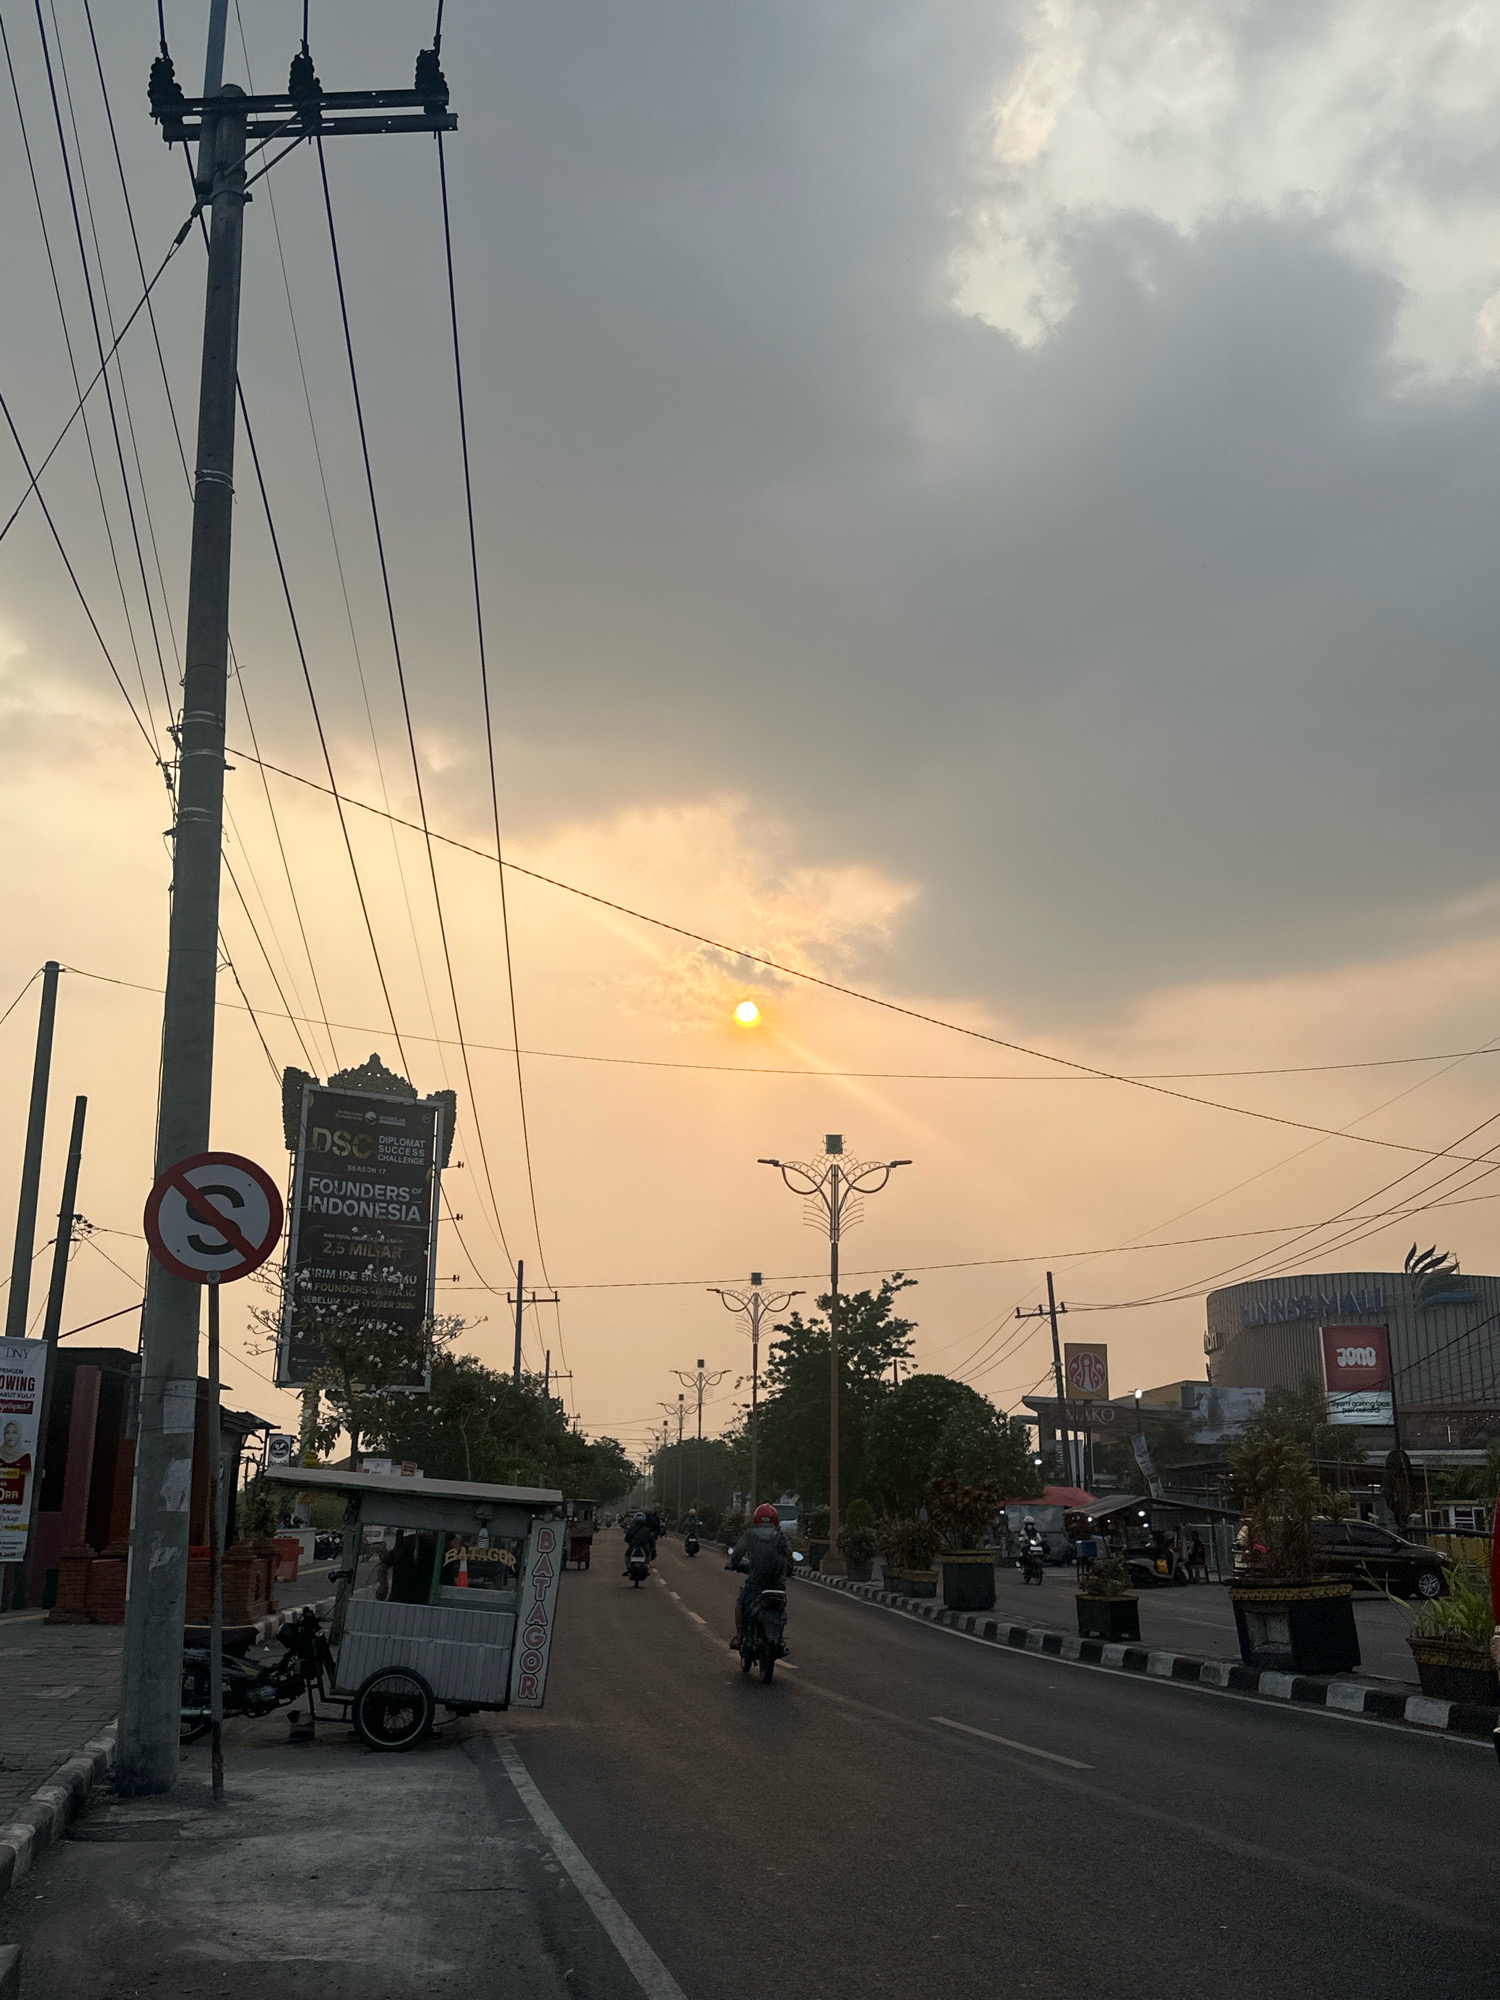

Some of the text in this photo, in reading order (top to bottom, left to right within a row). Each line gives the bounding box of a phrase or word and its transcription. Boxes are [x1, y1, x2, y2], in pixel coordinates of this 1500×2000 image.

[312, 1127, 375, 1159] DSC
[378, 1135, 426, 1148] DIPLOMAT
[378, 1144, 425, 1157] SUCCESS
[347, 1164, 377, 1174] SEASON
[377, 1153, 425, 1166] CHALLENGE
[308, 1176, 423, 1202] FOUNDERS OF
[307, 1194, 422, 1222] INDONESIA
[186, 1184, 245, 1256] S
[322, 1240, 345, 1257] 2,5
[338, 1271, 358, 1280] IDE
[1318, 1287, 1388, 1317] MALL
[6, 1347, 30, 1359] DNY
[1065, 1407, 1115, 1426] MAKO
[443, 1545, 517, 1573] BATAGOR
[519, 1528, 556, 1700] BATAGOR
